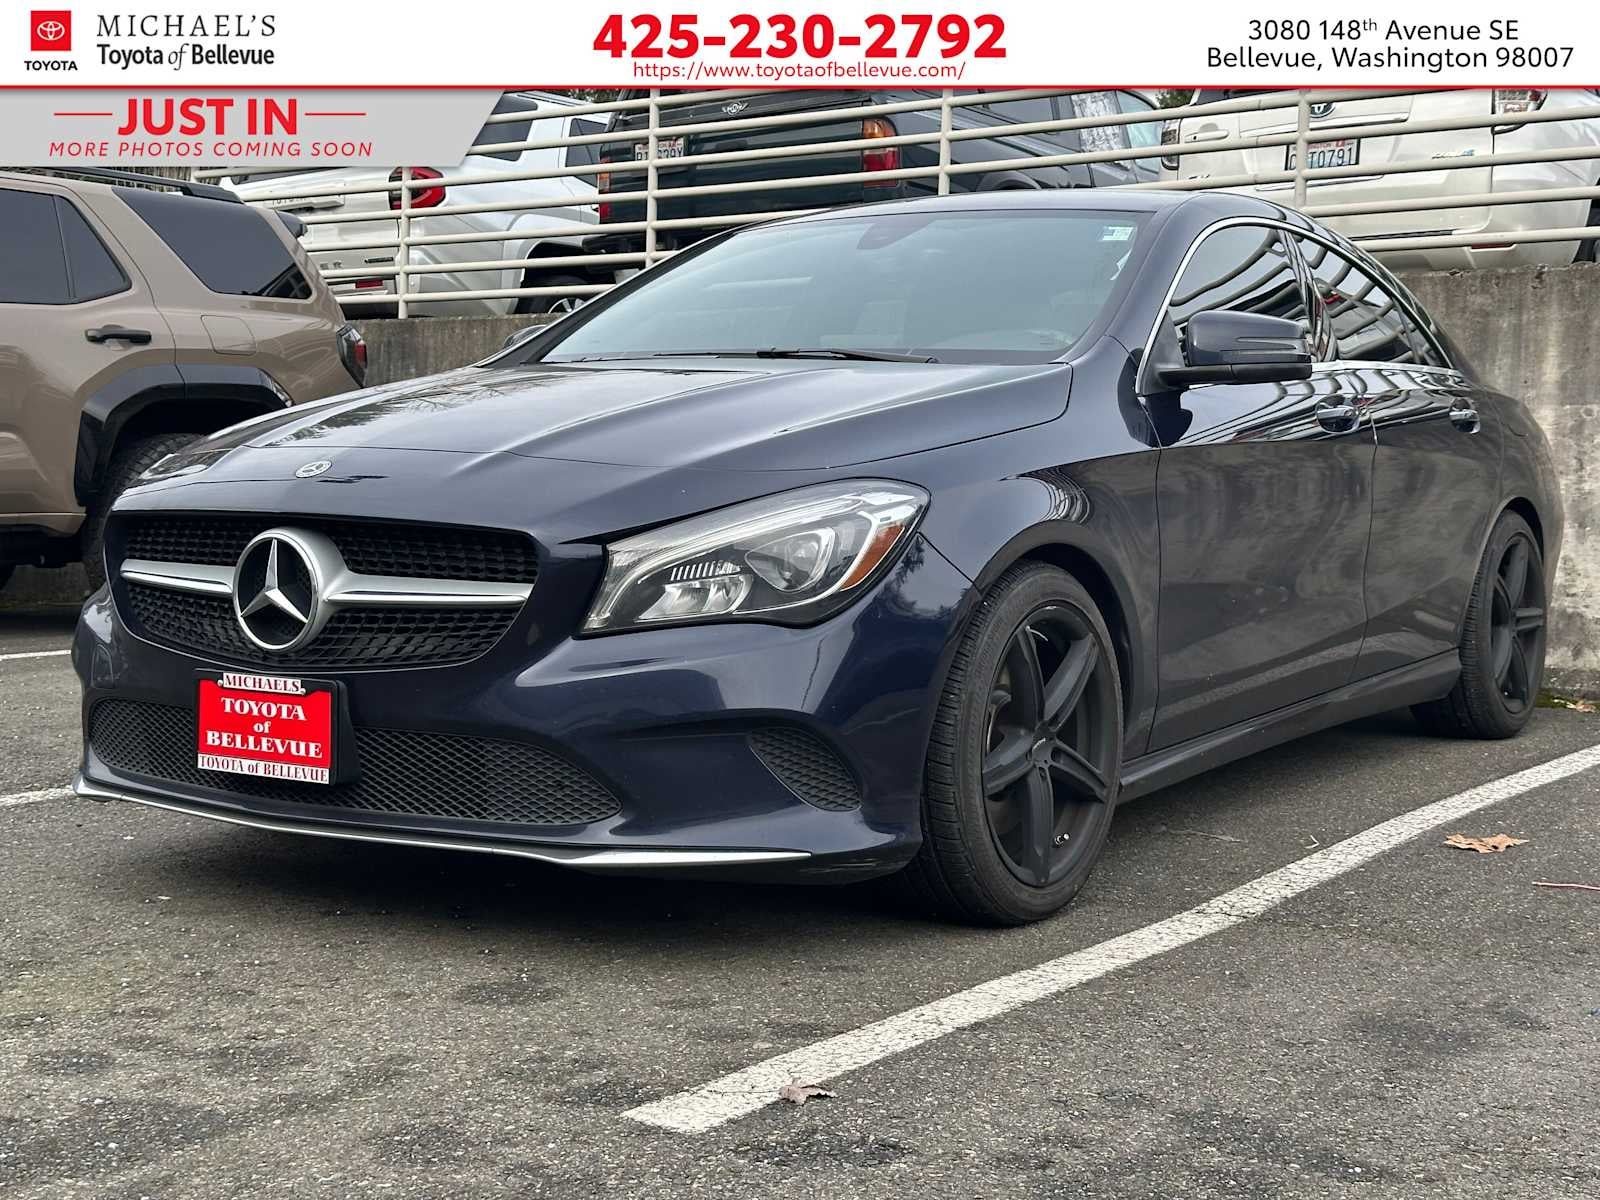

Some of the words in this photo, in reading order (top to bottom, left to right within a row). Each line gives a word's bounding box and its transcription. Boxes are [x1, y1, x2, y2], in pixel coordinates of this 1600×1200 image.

[225, 674, 299, 690] MICHAELS
[221, 697, 306, 720] TOYOTA
[253, 720, 271, 732] of
[206, 730, 322, 758] BELLEVUE
[199, 755, 244, 771] TOYOTA
[247, 762, 259, 774] of
[263, 762, 327, 782] BELLEVUE
